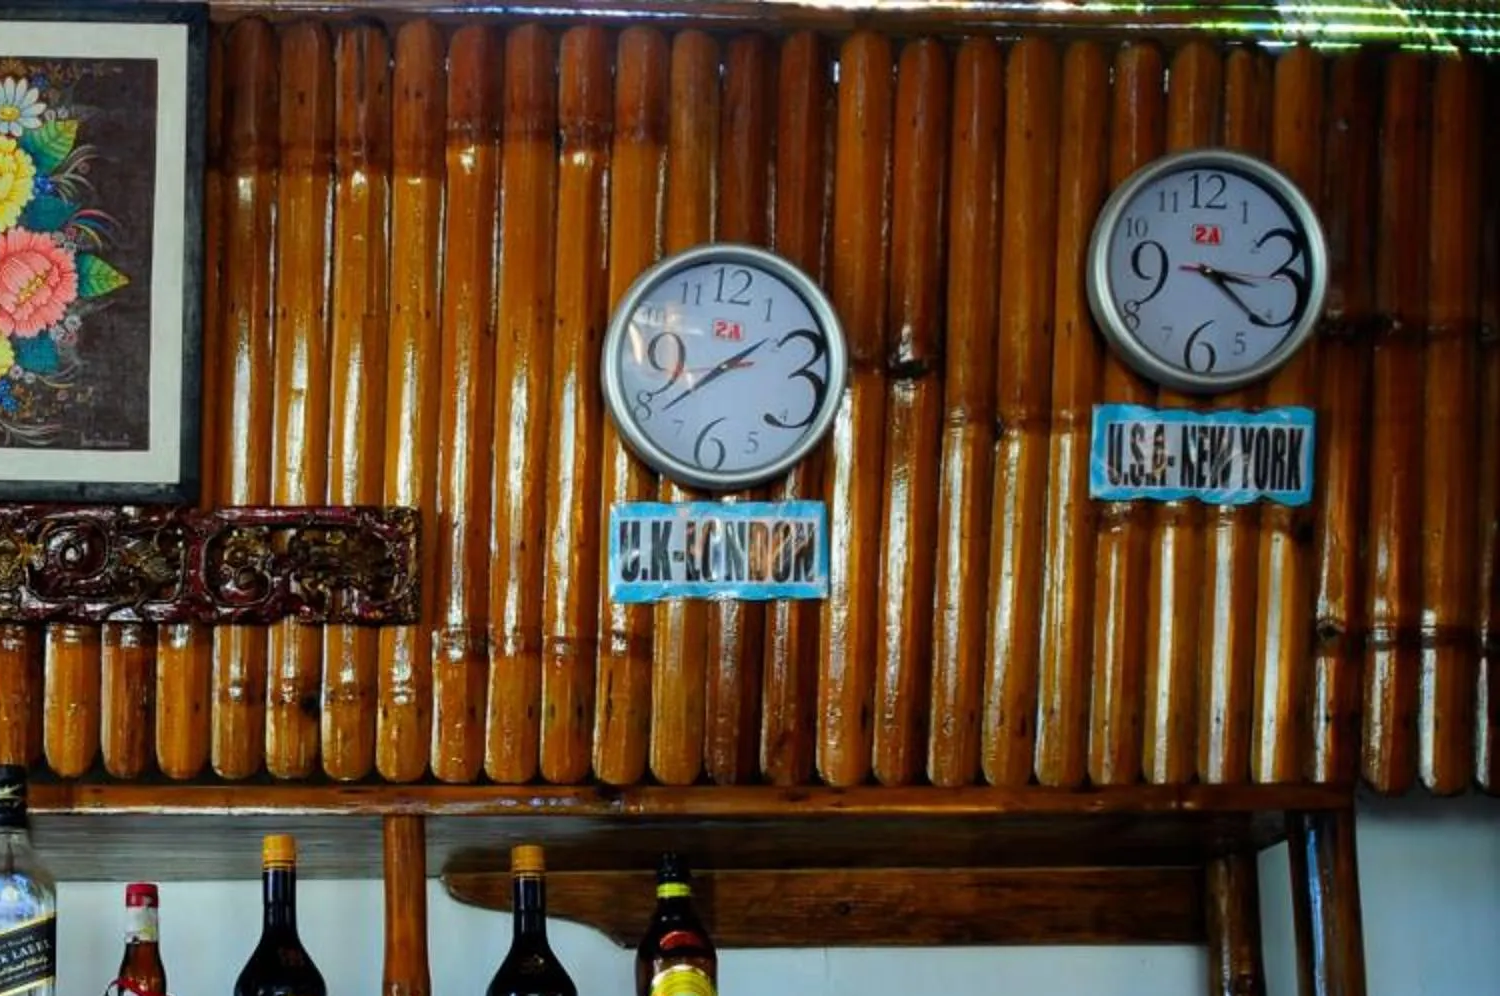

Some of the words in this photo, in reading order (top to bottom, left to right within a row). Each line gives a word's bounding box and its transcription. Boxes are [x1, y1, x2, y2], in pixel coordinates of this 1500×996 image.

[1158, 191, 1179, 214] 11
[1188, 173, 1227, 210] 12
[1126, 217, 1148, 237] 10
[1240, 201, 1250, 224] 1
[711, 267, 753, 306] 12
[1131, 240, 1169, 305] 9
[680, 281, 702, 306] 11
[764, 297, 773, 322] 1
[1124, 300, 1141, 330] 8
[1184, 319, 1216, 373] 6
[1233, 331, 1246, 356] 5
[647, 332, 687, 396] 9
[763, 328, 825, 429] 3
[694, 417, 725, 471] 6
[748, 431, 759, 454] 5
[1240, 426, 1304, 490] YORK
